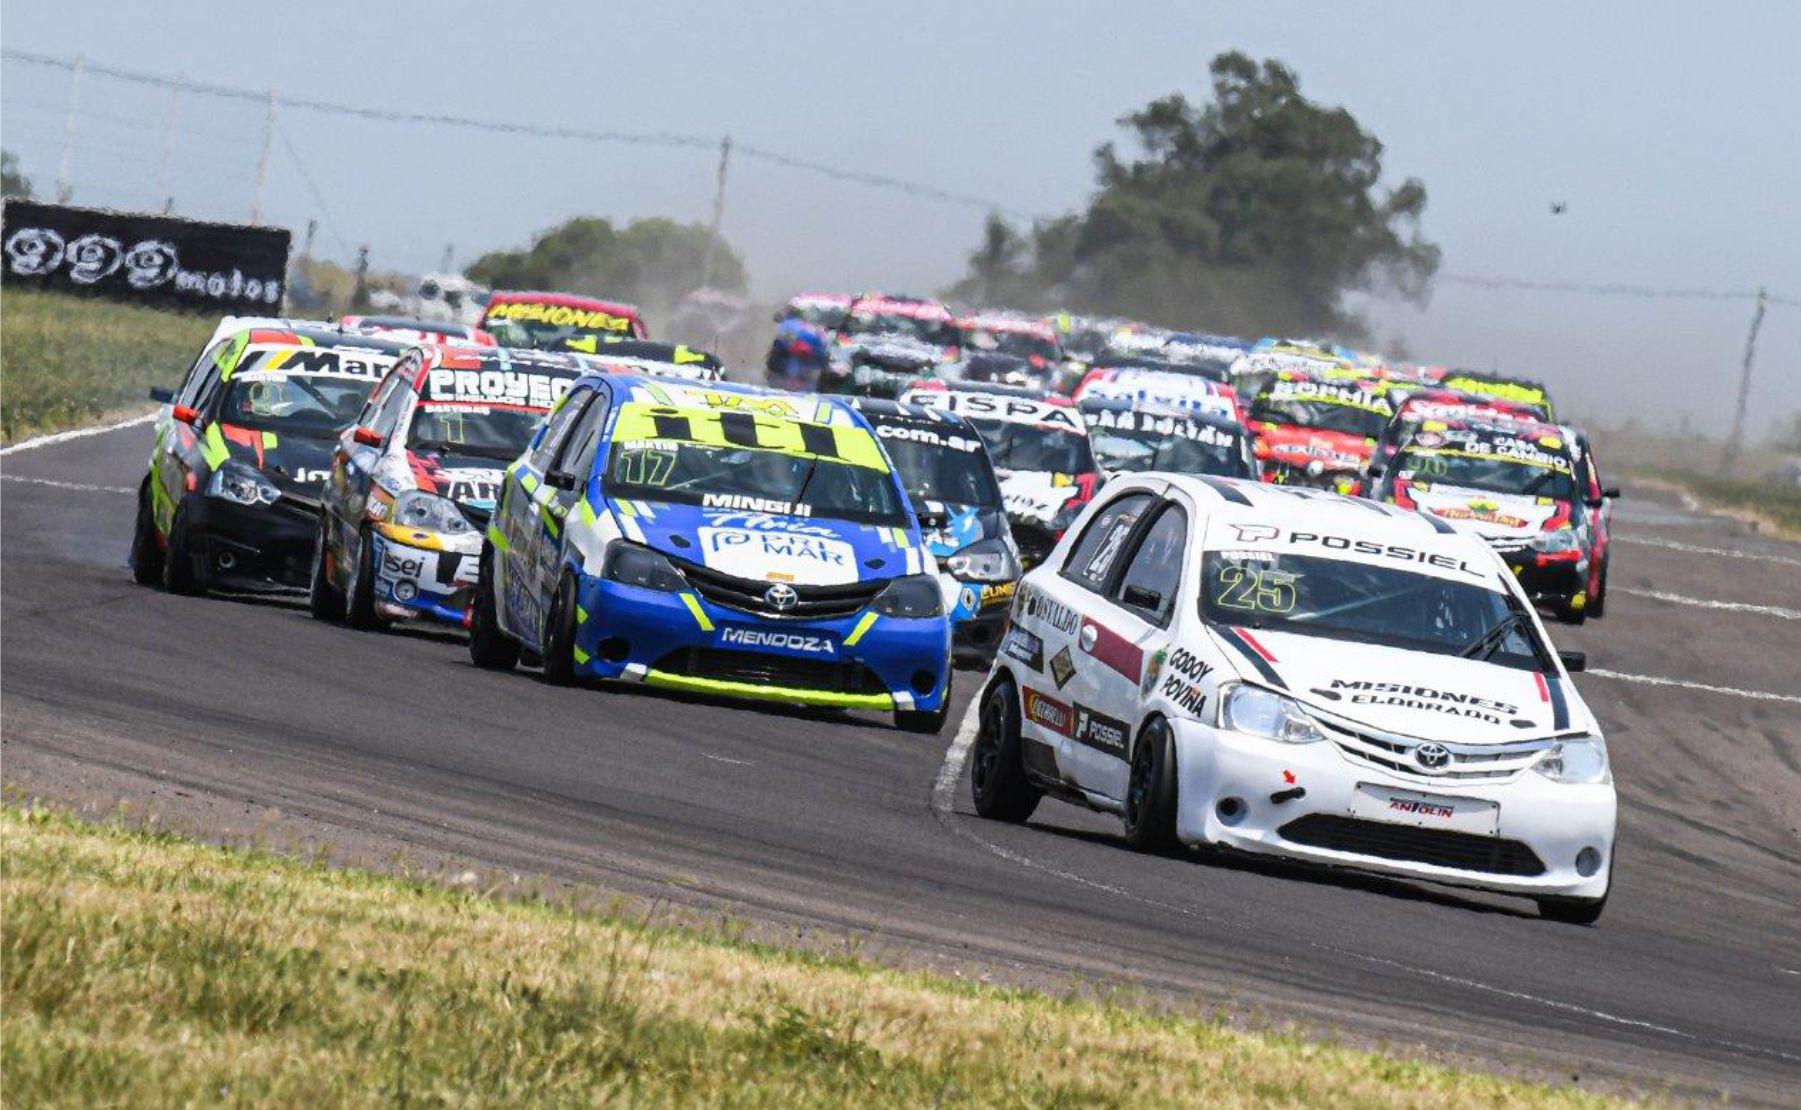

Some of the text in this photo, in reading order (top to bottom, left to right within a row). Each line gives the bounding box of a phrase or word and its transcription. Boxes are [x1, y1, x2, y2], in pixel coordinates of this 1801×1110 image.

[620, 449, 678, 486] 17
[763, 543, 844, 566] MAR
[1289, 531, 1486, 579] POSSIEL
[1217, 565, 1297, 613] 25
[721, 627, 835, 654] MENDOZA
[1168, 646, 1214, 684] GODOY
[1330, 679, 1520, 716] MISIONES
[1351, 694, 1501, 725] ELDORADO
[1088, 719, 1125, 749] POSSIEL
